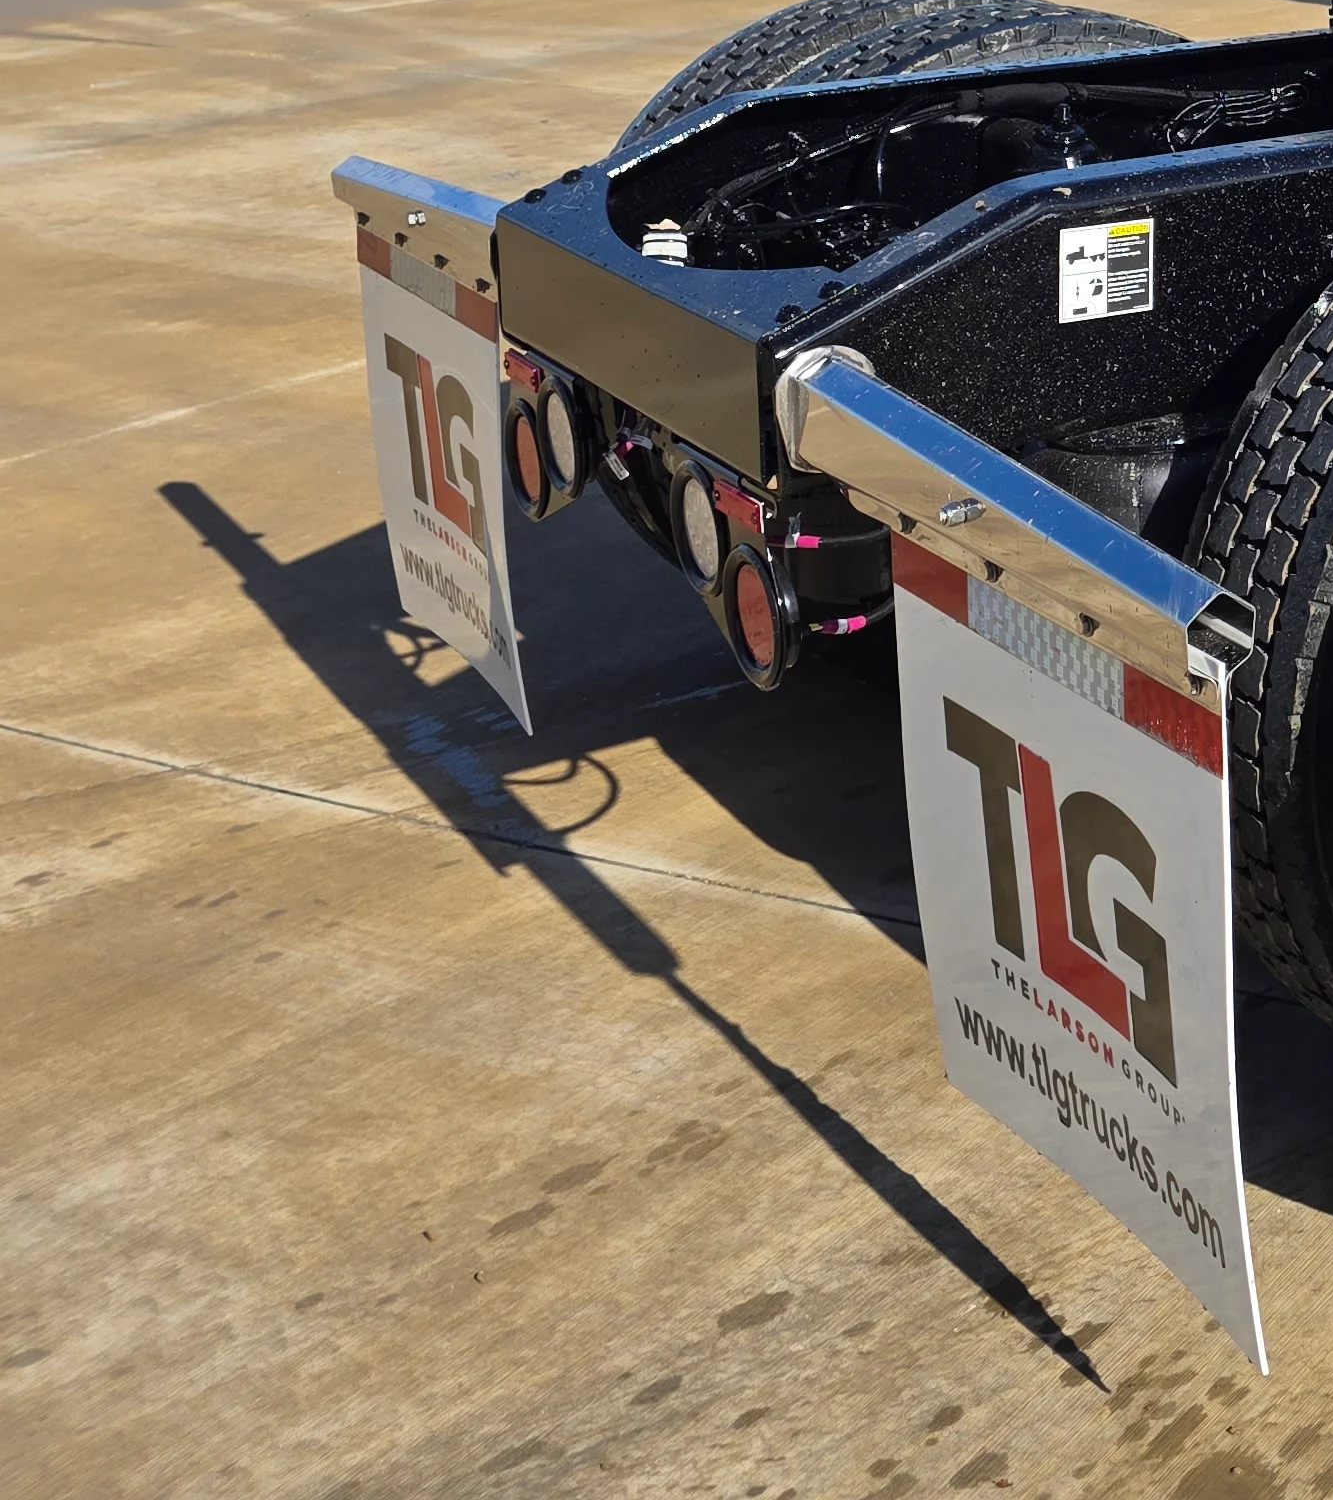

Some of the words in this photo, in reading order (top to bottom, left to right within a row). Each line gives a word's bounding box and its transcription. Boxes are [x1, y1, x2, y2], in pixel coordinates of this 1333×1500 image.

[1115, 224, 1149, 235] CAUTION
[384, 332, 489, 560] TLG
[399, 541, 513, 671] www.tlgtrucks.com
[943, 695, 1179, 1090] TLG
[954, 996, 1227, 1269] www.tlgtrucks.com
[1032, 988, 1116, 1069] LARSON
[1121, 1059, 1183, 1125] GROUP
